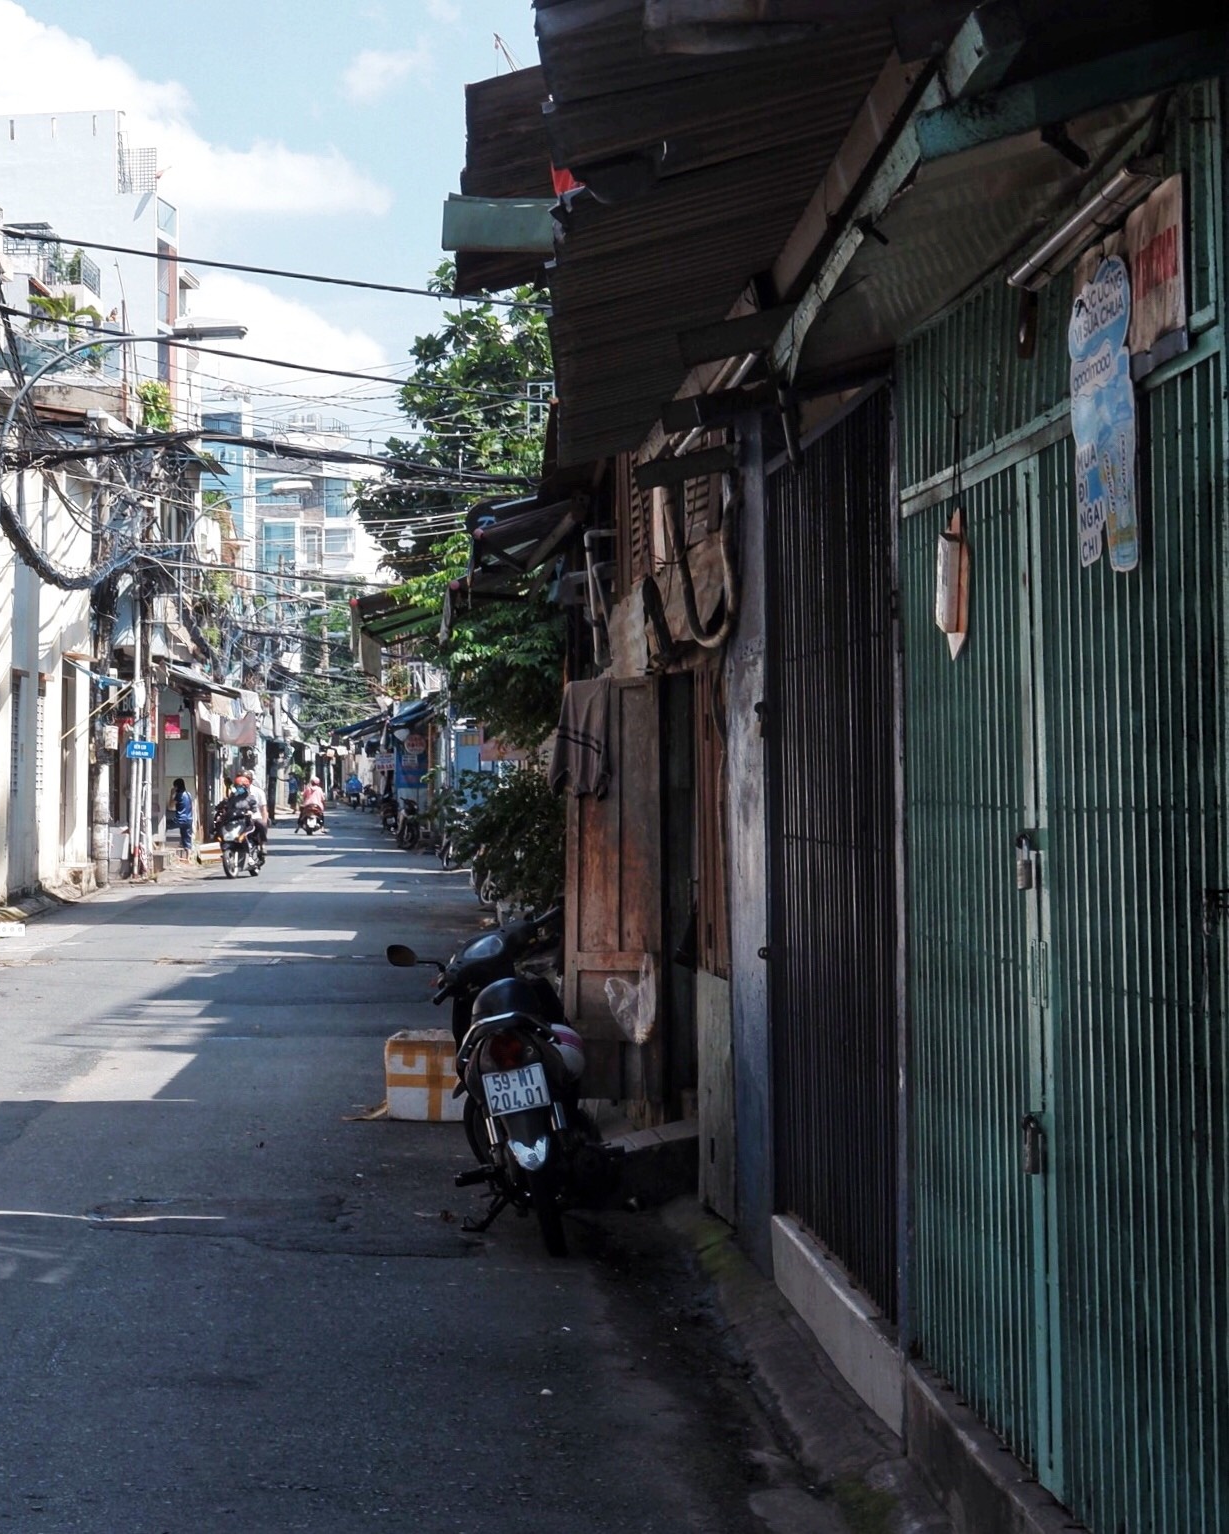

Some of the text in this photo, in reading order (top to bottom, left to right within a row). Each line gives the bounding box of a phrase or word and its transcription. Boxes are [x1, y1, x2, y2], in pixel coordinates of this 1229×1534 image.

[1100, 294, 1124, 325] CHUA
[1077, 444, 1097, 474] MUA
[1080, 501, 1104, 533] NGẠI
[1082, 535, 1099, 561] CHI
[491, 1086, 544, 1112] 204.01
